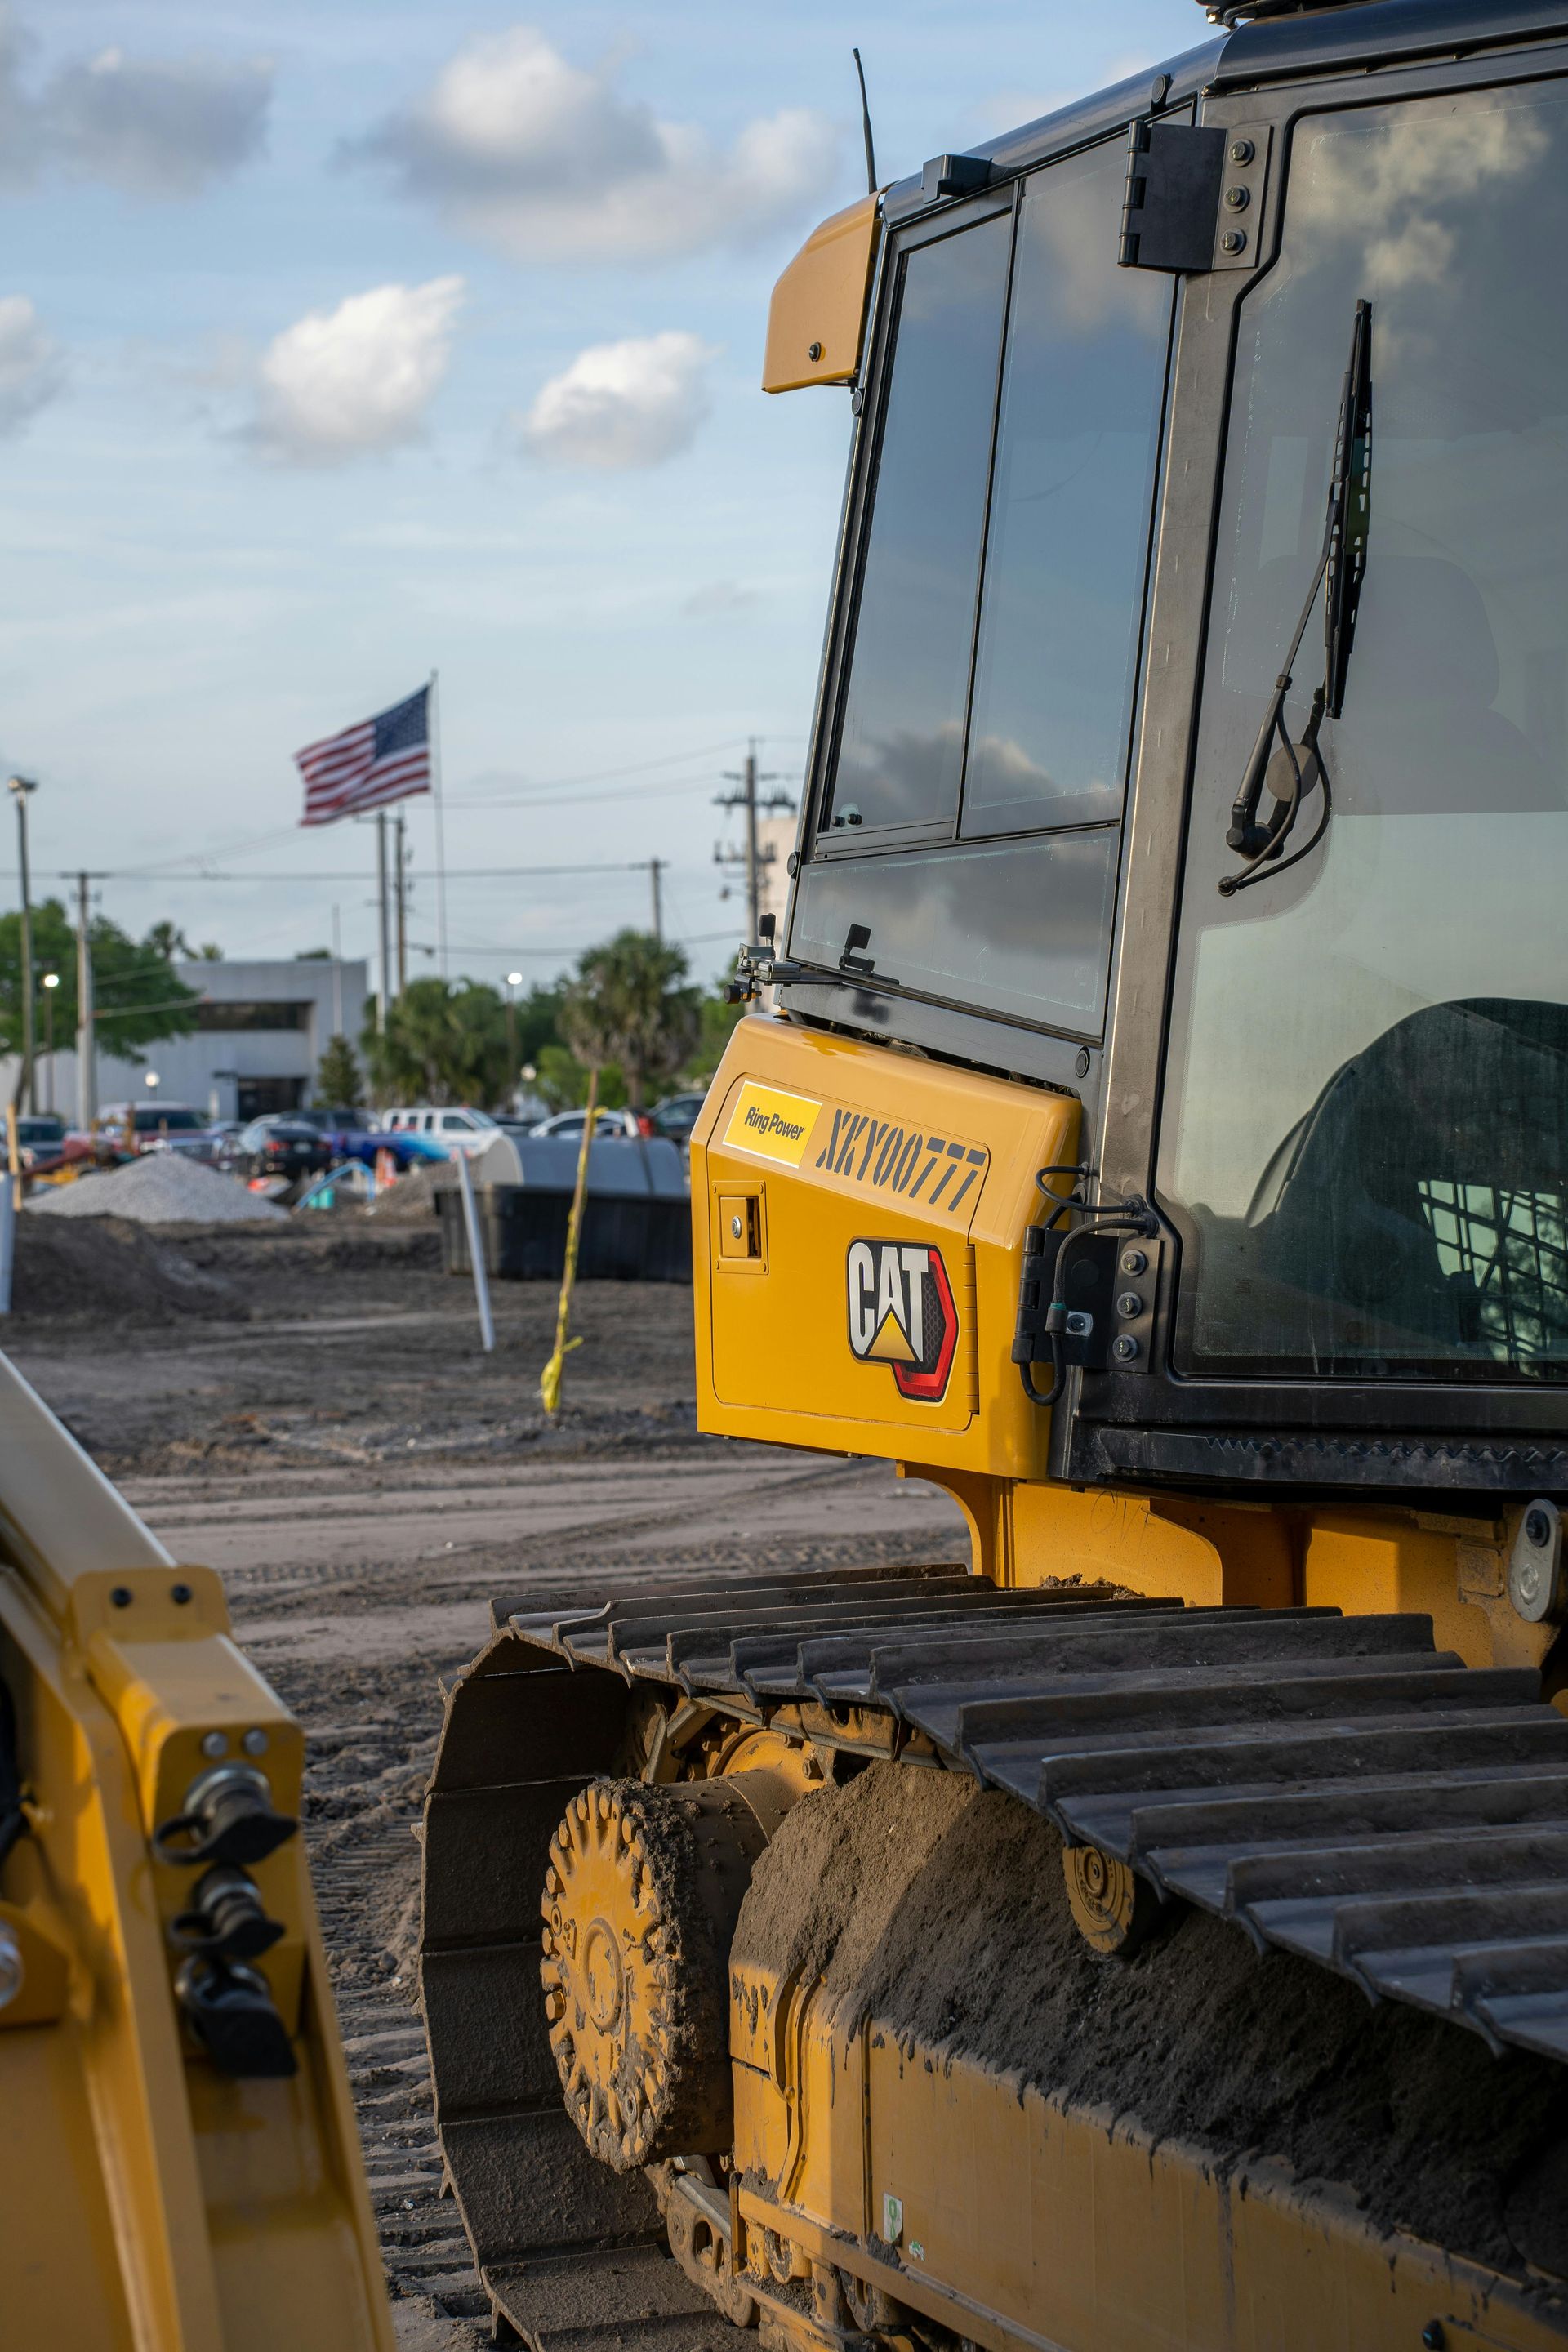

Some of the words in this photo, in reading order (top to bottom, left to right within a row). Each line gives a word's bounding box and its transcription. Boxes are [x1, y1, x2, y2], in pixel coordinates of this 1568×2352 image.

[744, 1106, 770, 1134] Ring
[768, 1113, 804, 1140] Power
[815, 1109, 987, 1212] XKY00777
[849, 1242, 929, 1362] CAT
